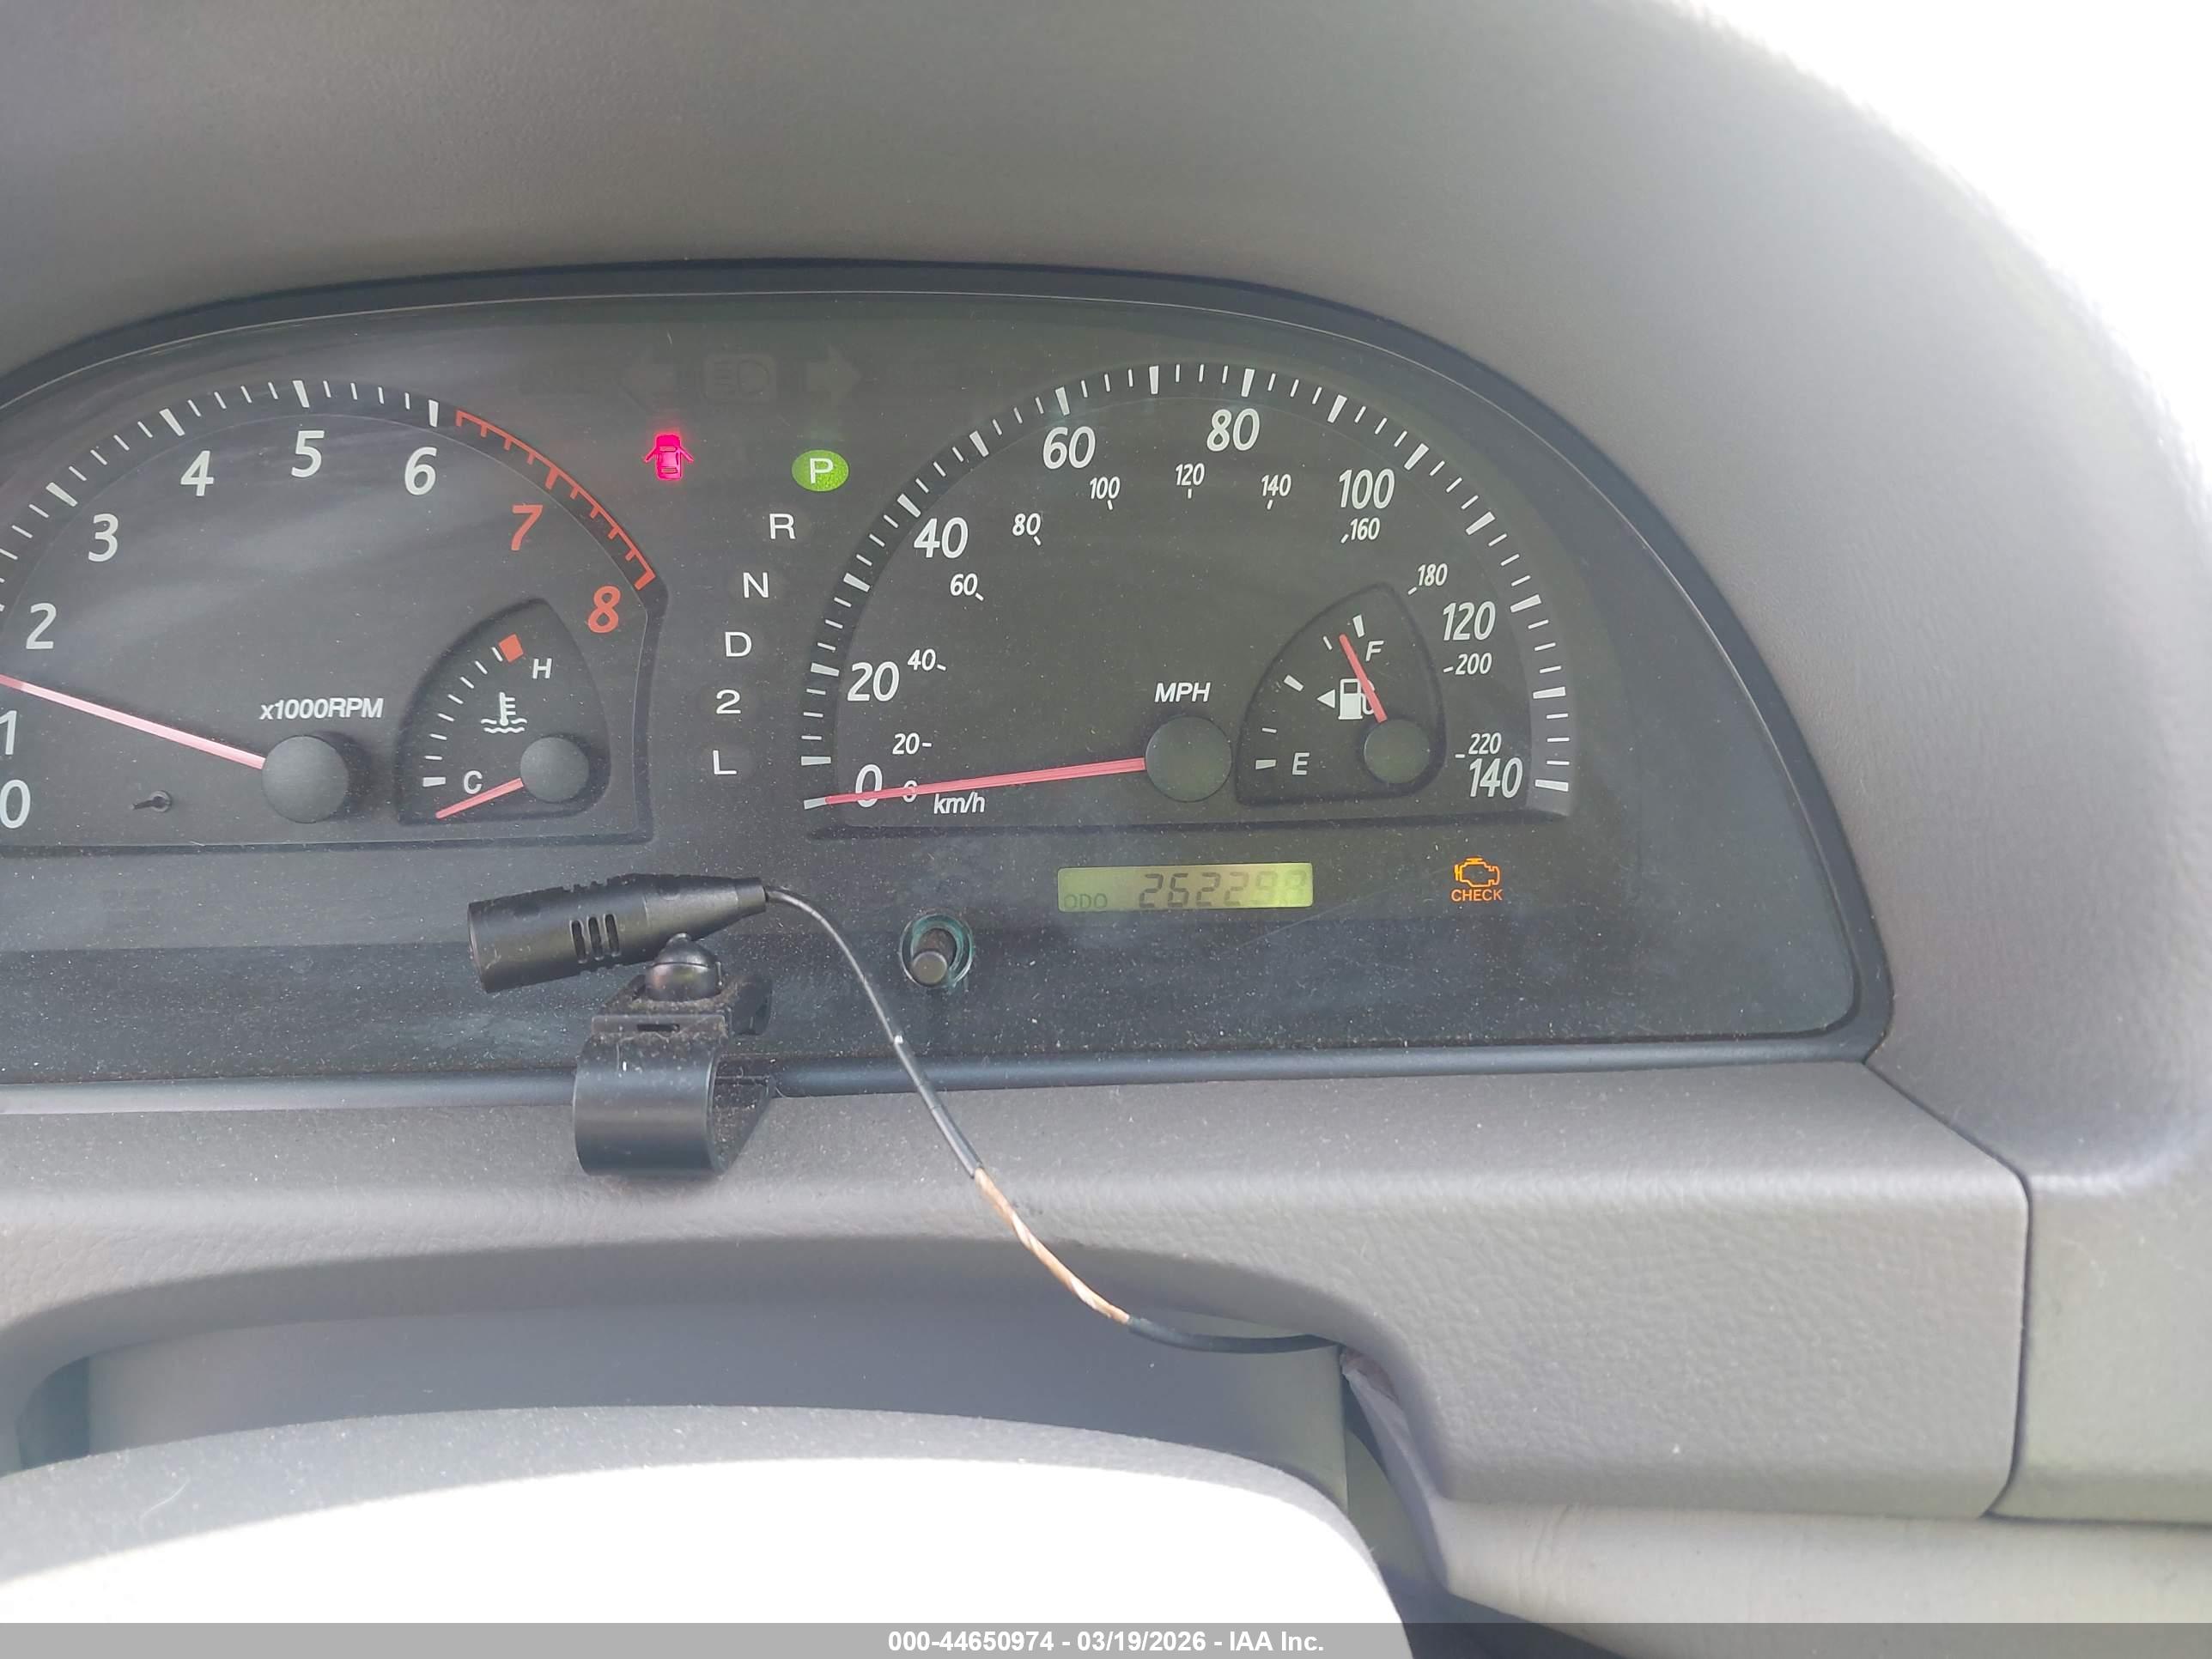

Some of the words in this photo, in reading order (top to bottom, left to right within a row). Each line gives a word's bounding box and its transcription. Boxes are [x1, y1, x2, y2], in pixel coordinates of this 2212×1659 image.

[1207, 409, 1259, 451] 80
[292, 431, 324, 477] 5
[1043, 427, 1095, 469] 60
[181, 451, 214, 495] 4
[405, 447, 436, 495] 6
[808, 457, 834, 483] P
[1176, 464, 1204, 485] 120
[1091, 477, 1120, 499] 100
[1262, 474, 1291, 495] 140
[1340, 469, 1395, 508] 100
[512, 504, 543, 550] 7
[770, 514, 795, 538] R
[1012, 514, 1041, 535] 80
[1351, 518, 1380, 540] 160
[88, 514, 118, 562] 3
[915, 518, 968, 558] 40
[744, 573, 768, 598] N
[950, 574, 977, 596] 60
[1419, 563, 1447, 586] 180
[588, 586, 620, 633] 8
[1443, 602, 1495, 640] 120
[26, 603, 56, 649] 2
[726, 632, 751, 656] D
[1366, 641, 1383, 661] F
[532, 658, 552, 679] H
[908, 649, 935, 671] 40
[1455, 653, 1492, 674] 200
[848, 662, 899, 701] 20
[1155, 683, 1210, 702] MPH
[259, 698, 383, 720] x1000RPM
[717, 690, 740, 714] 2
[0, 711, 16, 755] 1
[892, 732, 920, 755] 20
[1468, 732, 1501, 754] 220
[714, 750, 737, 775] L
[1292, 753, 1310, 775] E
[463, 771, 483, 794] C
[852, 763, 882, 807] 0
[1470, 757, 1522, 798] 140
[0, 780, 30, 828] 0
[934, 792, 985, 814] km/h
[1064, 892, 1108, 911] ODO
[1451, 889, 1504, 902] CHECK
